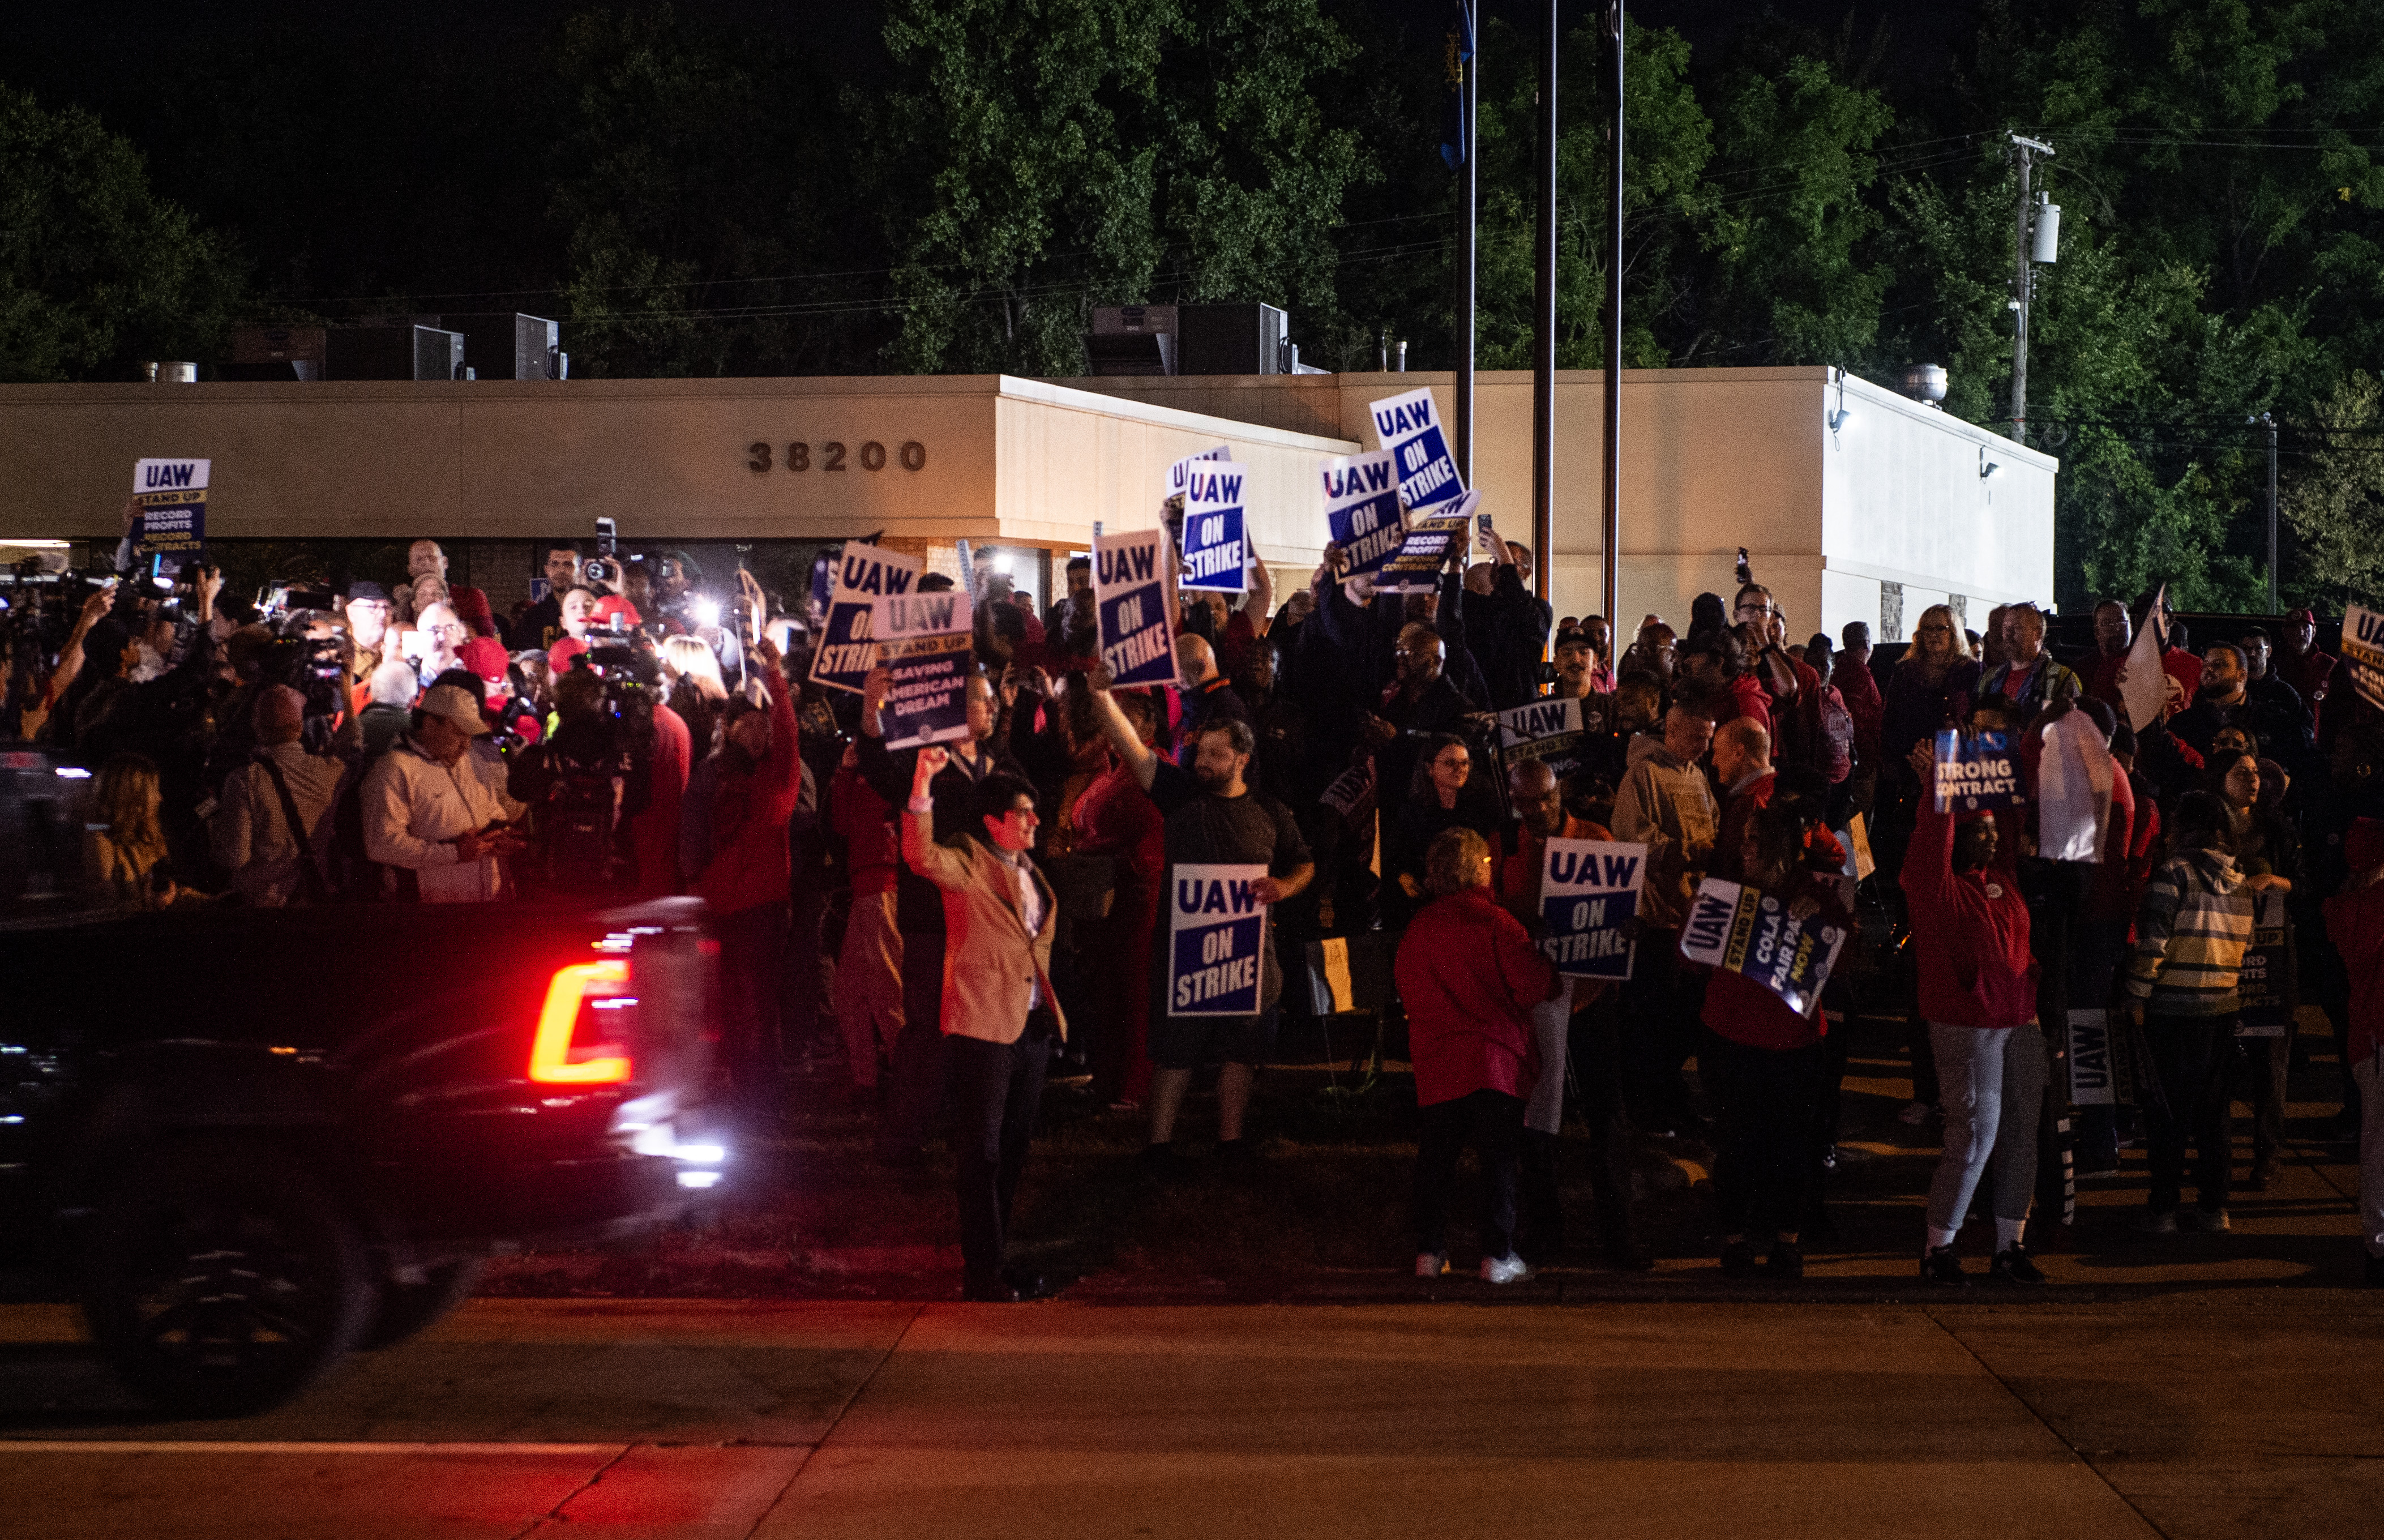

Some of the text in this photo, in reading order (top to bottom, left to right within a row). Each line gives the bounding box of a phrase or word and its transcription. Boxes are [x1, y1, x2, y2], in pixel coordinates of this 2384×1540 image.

[1376, 399, 1431, 437] UAW
[749, 441, 926, 473] 38200
[1403, 438, 1429, 473] ON
[147, 464, 194, 487] UAW
[1190, 473, 1243, 504] UAW
[1324, 461, 1390, 498] UAW
[1399, 455, 1454, 506] STRIKE
[183, 492, 201, 502] UP
[143, 519, 193, 531] PROFITS
[144, 510, 193, 521] RECORD
[1201, 513, 1225, 547] ON
[1352, 502, 1379, 537] ON
[1098, 544, 1155, 586] UAW
[1183, 539, 1242, 582] STRIKE
[1339, 521, 1403, 574] STRIKE
[843, 555, 913, 596] UAW
[889, 596, 956, 632] UAW
[1117, 594, 1144, 635] ON
[819, 643, 878, 675] STRIK
[881, 635, 966, 658] STAND UP
[1105, 622, 1170, 680] STRIKE
[892, 660, 955, 681] SAVING
[883, 675, 965, 703] AMERICAN
[894, 692, 951, 717] DREAM
[1513, 703, 1566, 738] UAW
[1551, 852, 1638, 888] UAW
[1178, 879, 1257, 914] UAW
[1572, 898, 1607, 930] ON
[1686, 893, 1732, 949] UAW
[1728, 893, 1757, 966] STAND UP
[1756, 914, 1782, 964] COLA
[1202, 926, 1234, 965] ON
[1543, 927, 1627, 964] STRIKE
[1770, 919, 1803, 991] FAIR PA
[1790, 931, 1815, 983] NOW
[1176, 954, 1255, 1008] STRIKE
[2073, 1024, 2107, 1088] UAW
